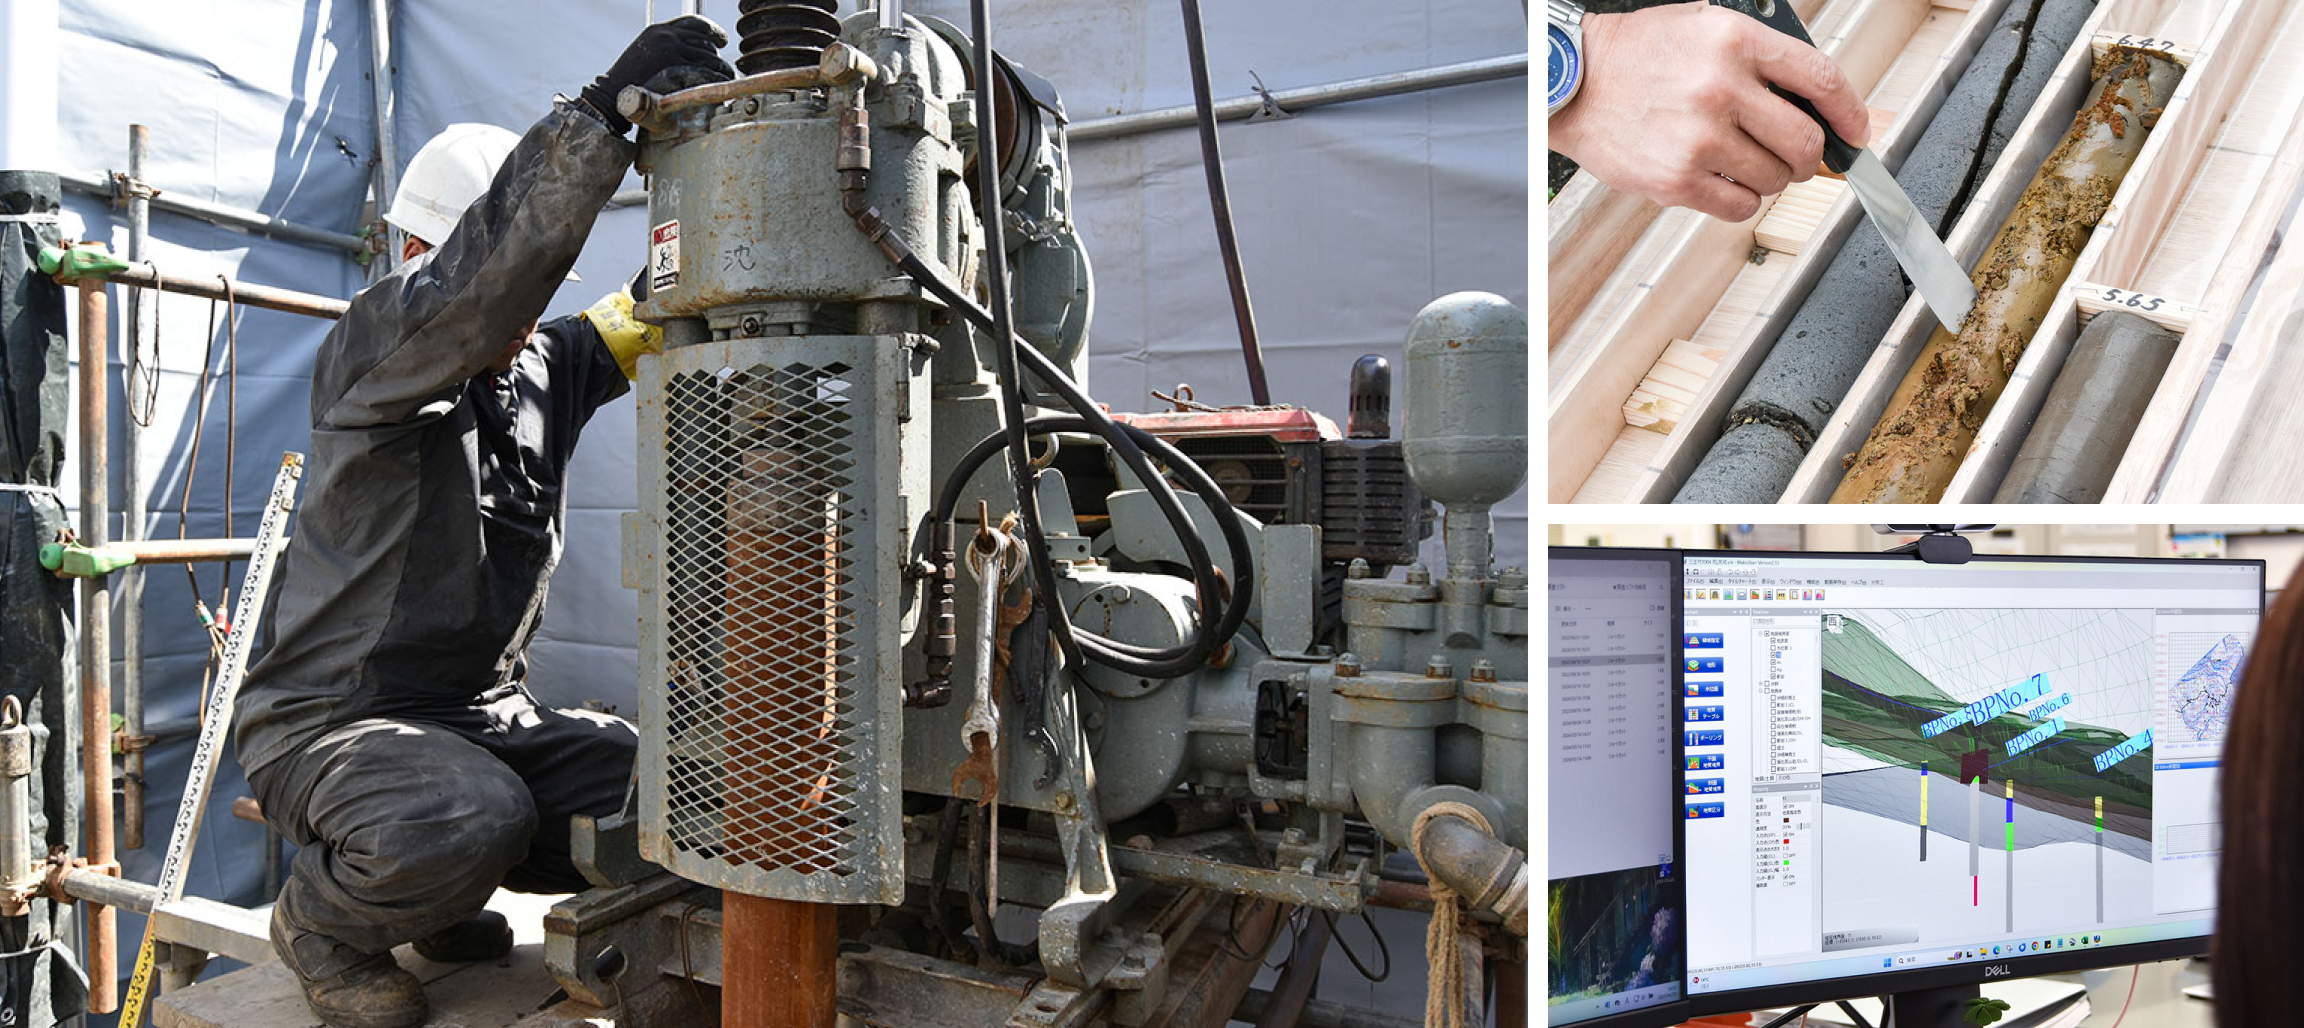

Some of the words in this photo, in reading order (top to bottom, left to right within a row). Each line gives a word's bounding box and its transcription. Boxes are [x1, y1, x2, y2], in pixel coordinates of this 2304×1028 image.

[2118, 34, 2174, 50] 6.47
[2102, 288, 2165, 311] 5.65
[1970, 688, 2029, 726] BPNo.
[2032, 674, 2042, 696] 7
[2029, 702, 2060, 723] BPNo.
[2062, 694, 2070, 705] 6
[1921, 715, 1962, 739] BPNo.
[2006, 729, 2048, 757] BPNo.
[2051, 718, 2059, 734] 1
[2094, 743, 2140, 773] BPNo.
[2144, 729, 2153, 746] 4
[1985, 964, 2011, 977] DELL
